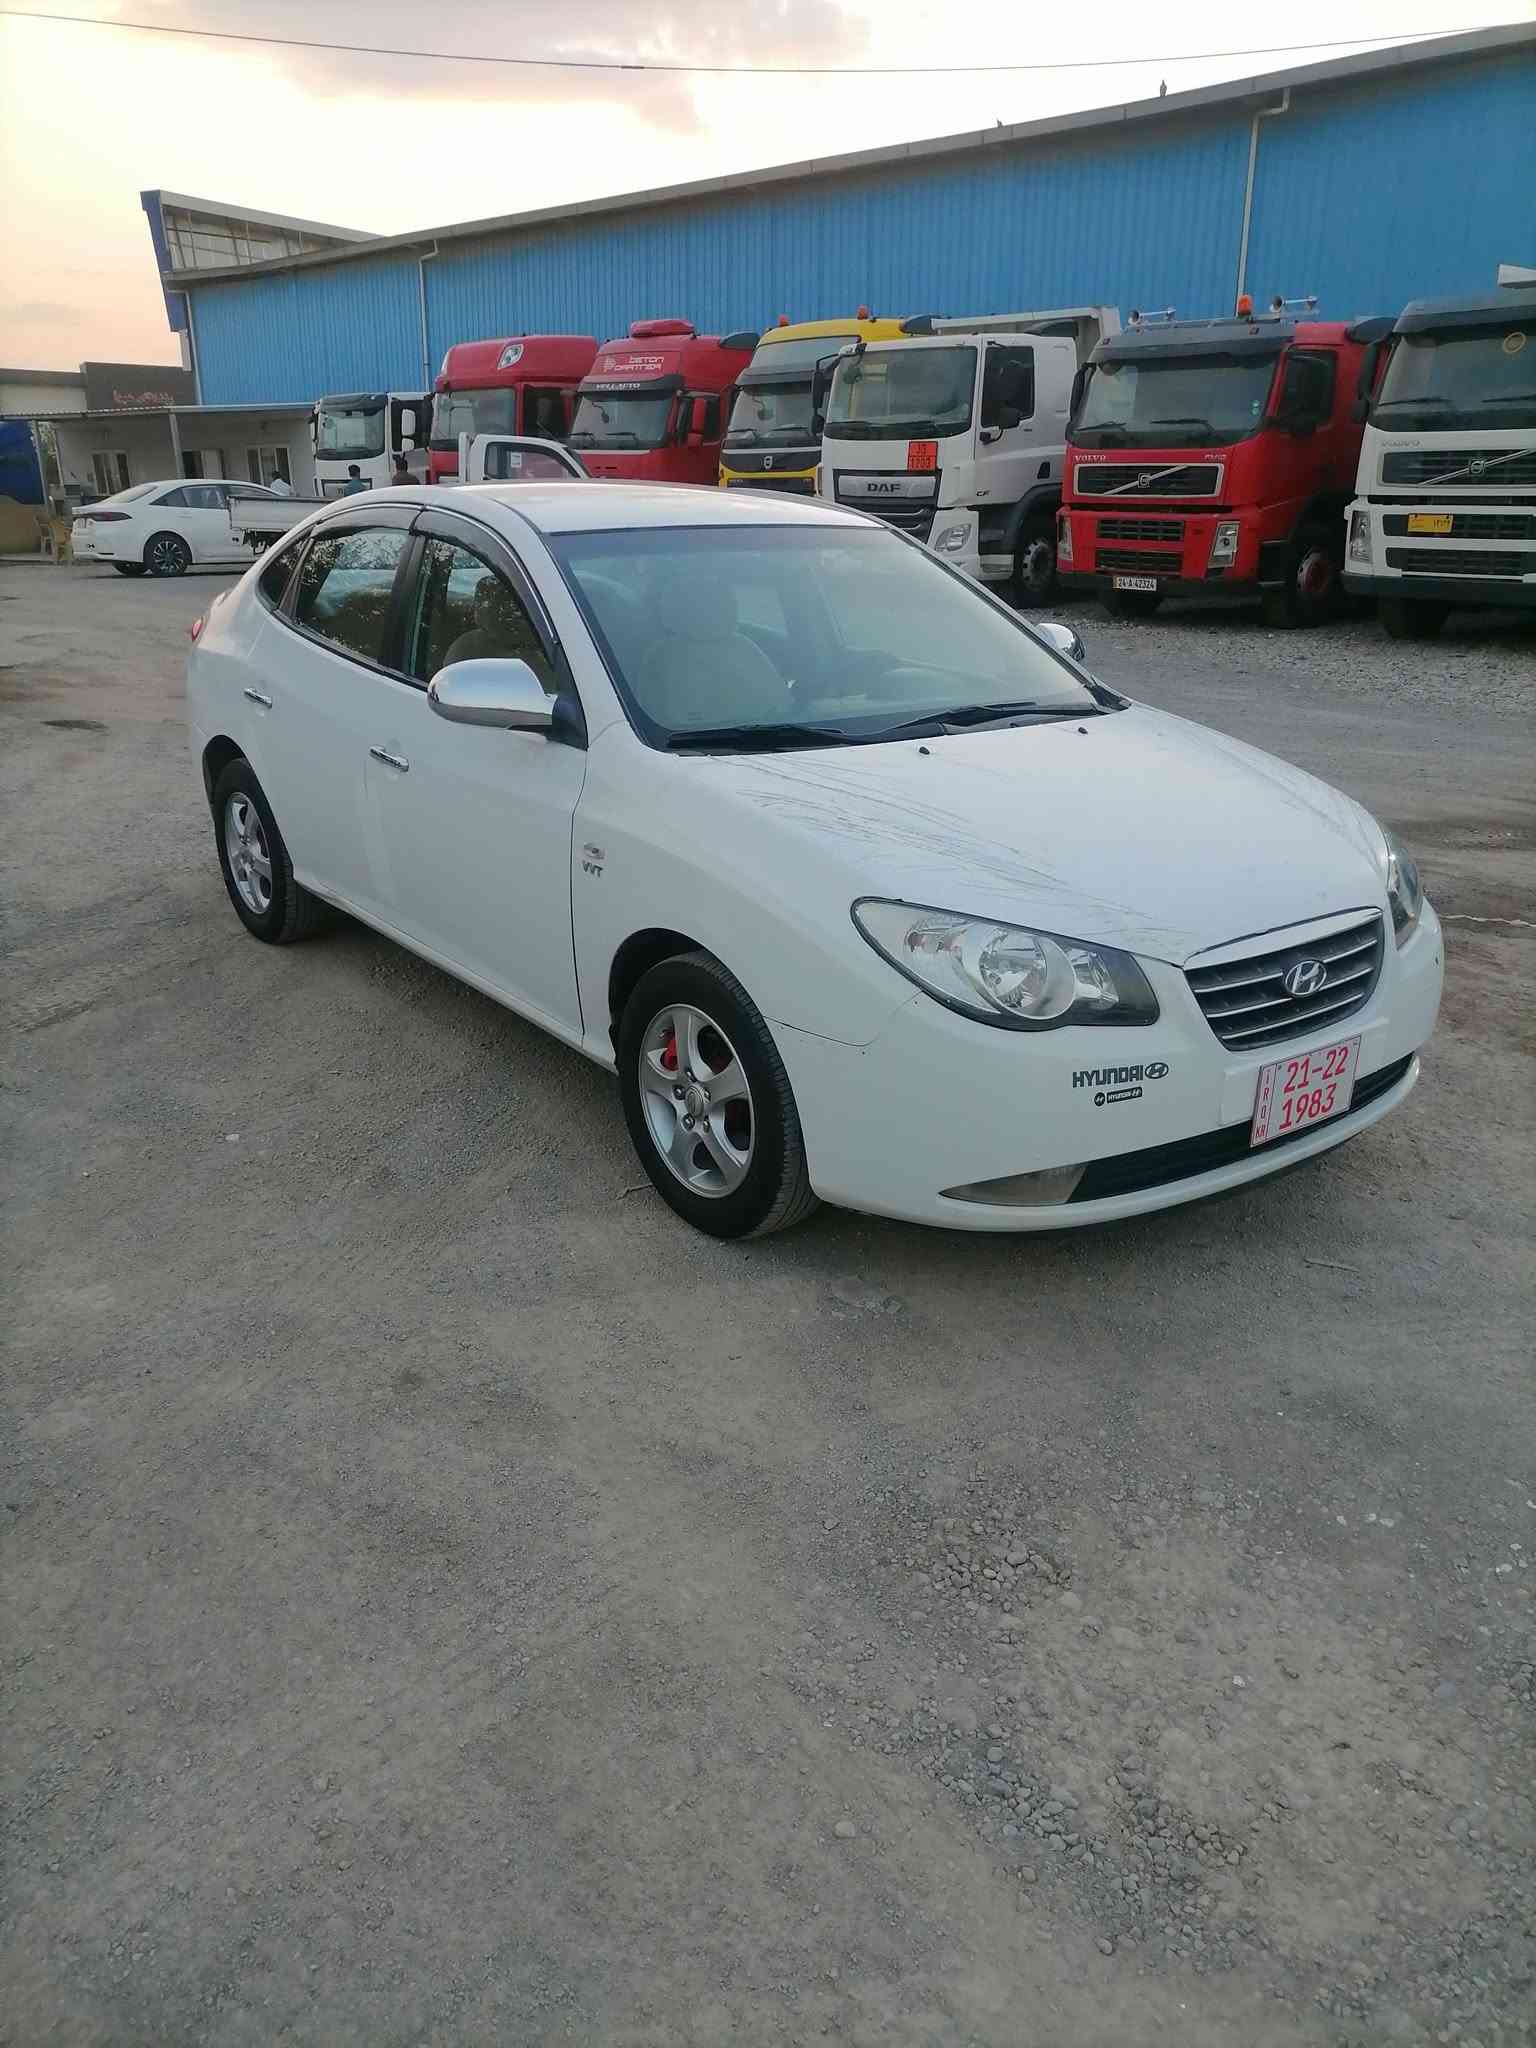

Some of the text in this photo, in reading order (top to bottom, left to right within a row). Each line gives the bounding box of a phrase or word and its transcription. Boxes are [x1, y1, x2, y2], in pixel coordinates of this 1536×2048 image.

[1075, 454, 1106, 463] VOLVO
[866, 483, 902, 493] DAF
[582, 860, 603, 878] VVT
[1072, 1064, 1144, 1088] HYUNDAI
[1283, 1046, 1349, 1093] 21-22
[1279, 1083, 1337, 1130] 1983
